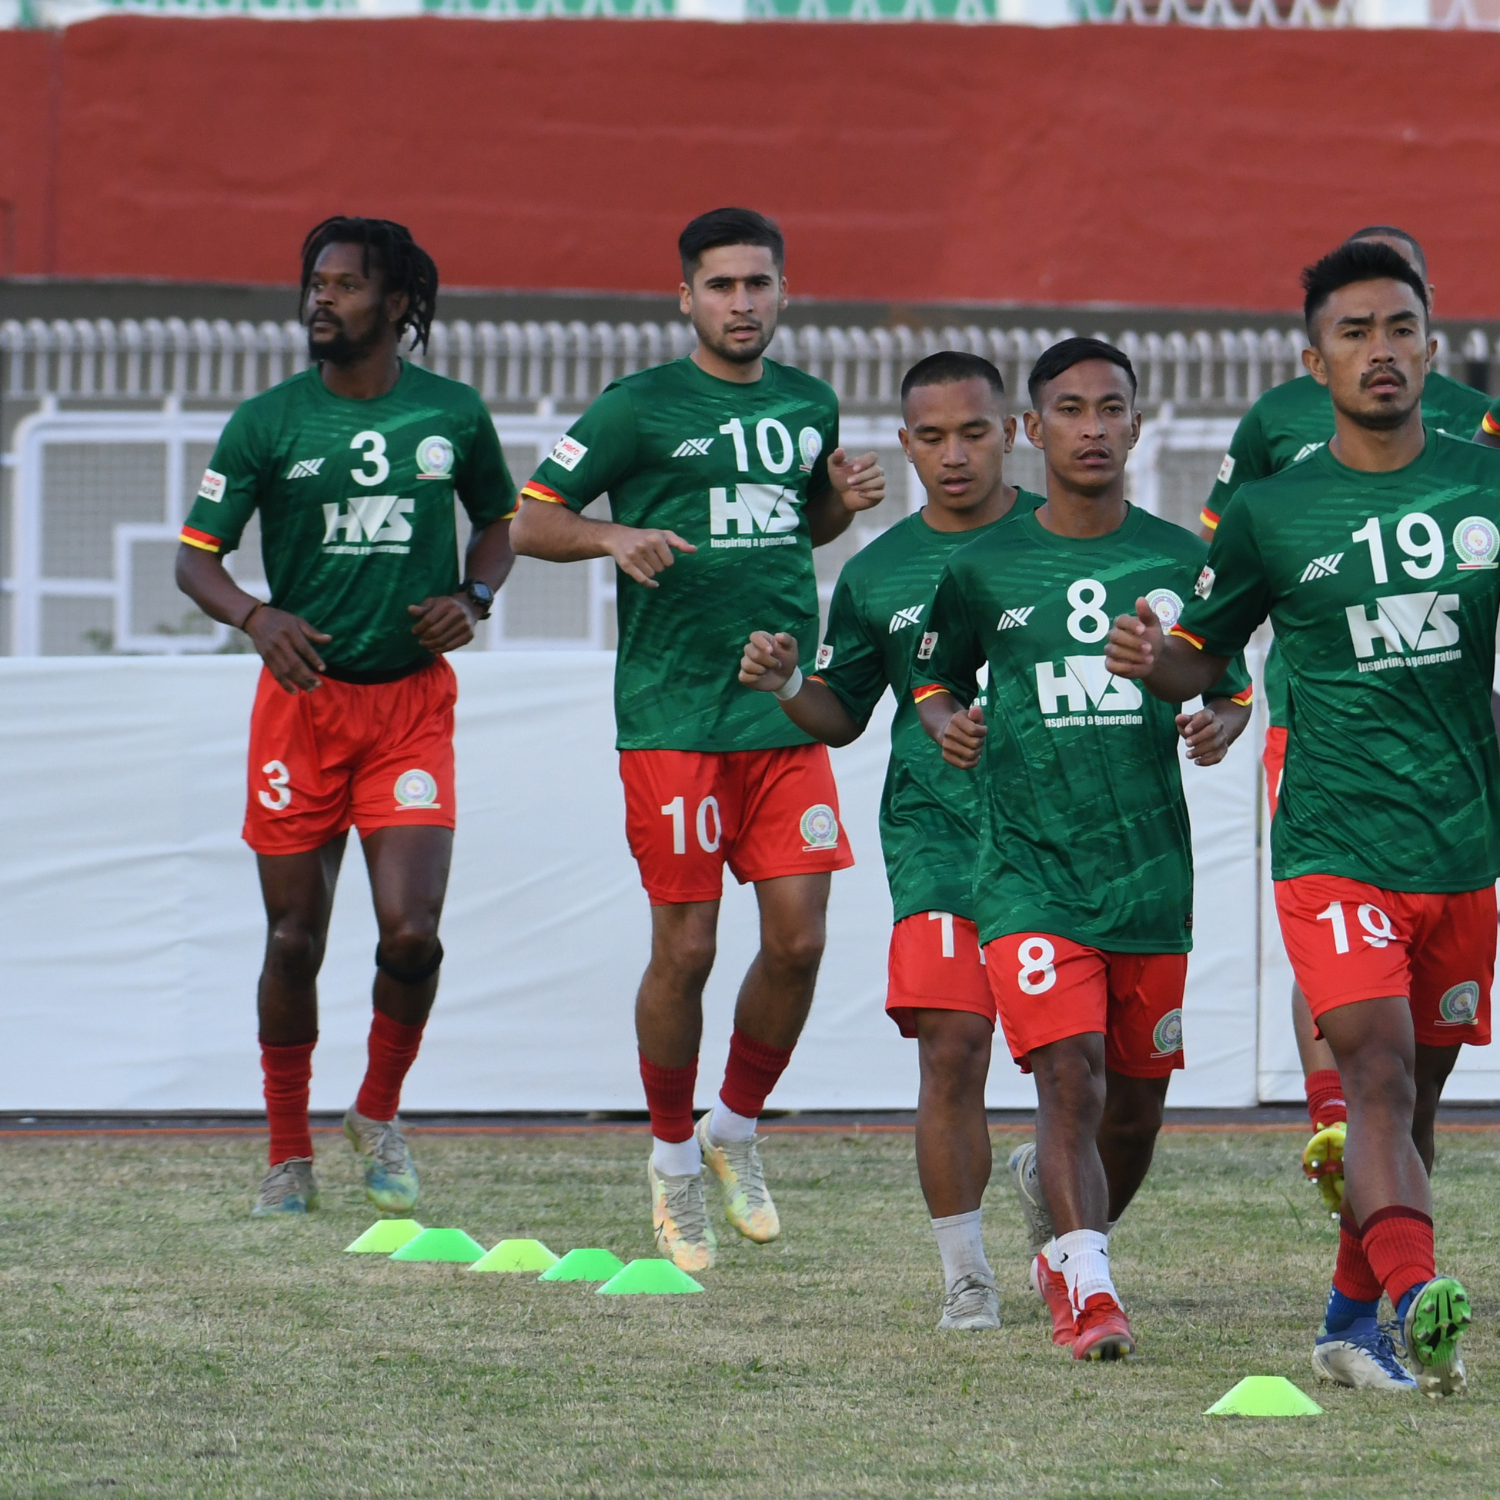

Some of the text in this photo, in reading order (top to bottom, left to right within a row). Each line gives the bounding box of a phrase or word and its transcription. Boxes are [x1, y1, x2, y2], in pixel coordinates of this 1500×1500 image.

[350, 431, 390, 486] 3
[719, 418, 794, 474] 10
[711, 537, 752, 549] Inspiring
[1352, 512, 1445, 584] 19
[1067, 579, 1110, 643] 8
[1358, 656, 1405, 673] Inspiring
[1411, 649, 1462, 668] generation
[1044, 715, 1086, 728] nspiring
[259, 760, 292, 811] 3
[661, 795, 722, 854] 10
[1316, 901, 1397, 955] 19
[1017, 937, 1057, 995] 8
